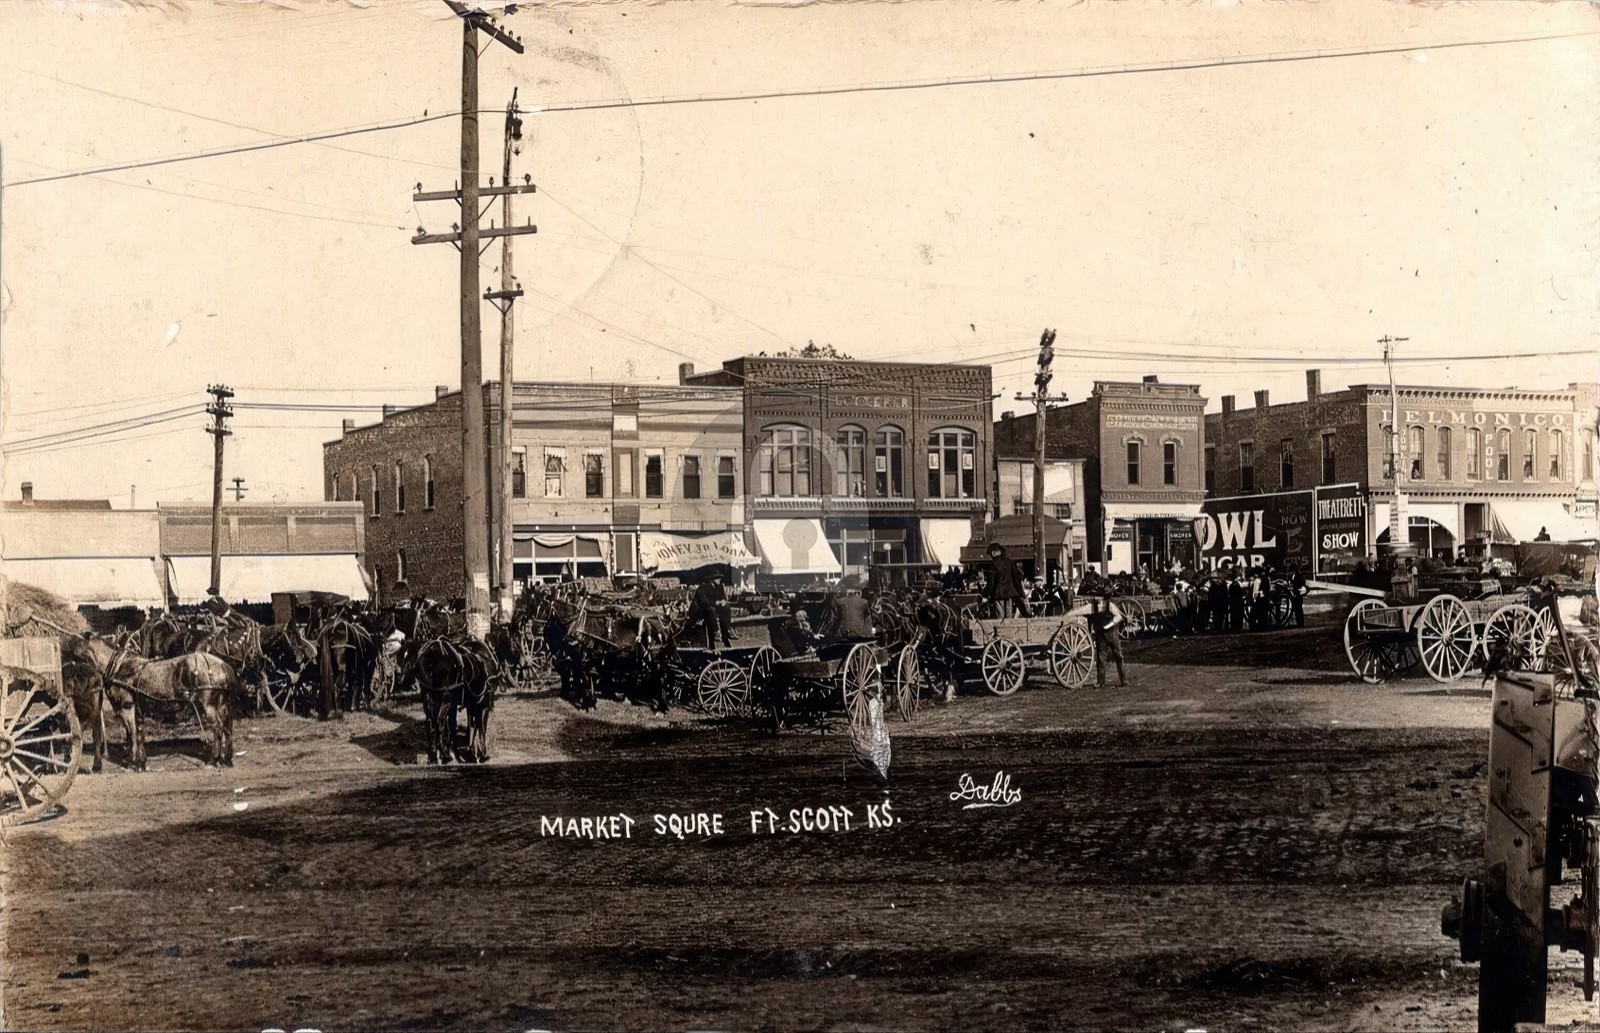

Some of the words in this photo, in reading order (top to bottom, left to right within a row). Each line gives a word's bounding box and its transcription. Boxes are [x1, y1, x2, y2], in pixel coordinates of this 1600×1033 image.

[1381, 409, 1564, 426] DELMONICO
[1485, 433, 1494, 480] POOL
[1281, 513, 1308, 526] NOW
[1200, 509, 1276, 551] OWL
[1322, 531, 1360, 549] SHOW
[657, 543, 691, 560] ONEY
